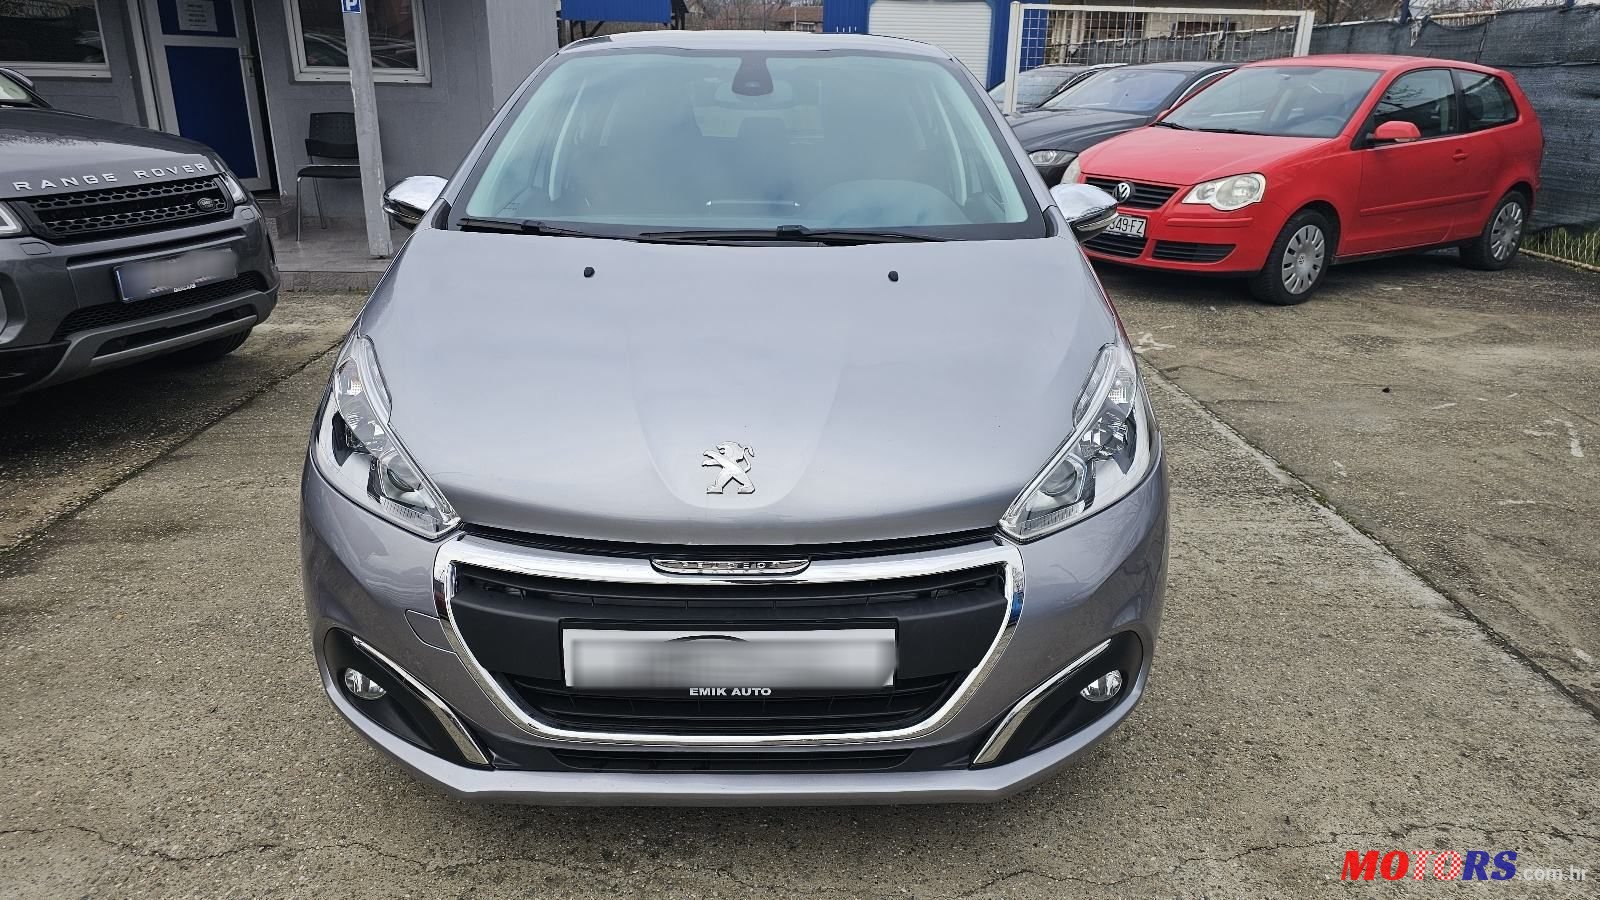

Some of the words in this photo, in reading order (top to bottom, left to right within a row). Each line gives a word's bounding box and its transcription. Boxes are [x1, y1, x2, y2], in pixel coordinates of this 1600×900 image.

[12, 173, 118, 192] RANGE
[133, 163, 208, 180] ROVER
[689, 687, 727, 696] EMIK
[731, 687, 772, 696] AUTO
